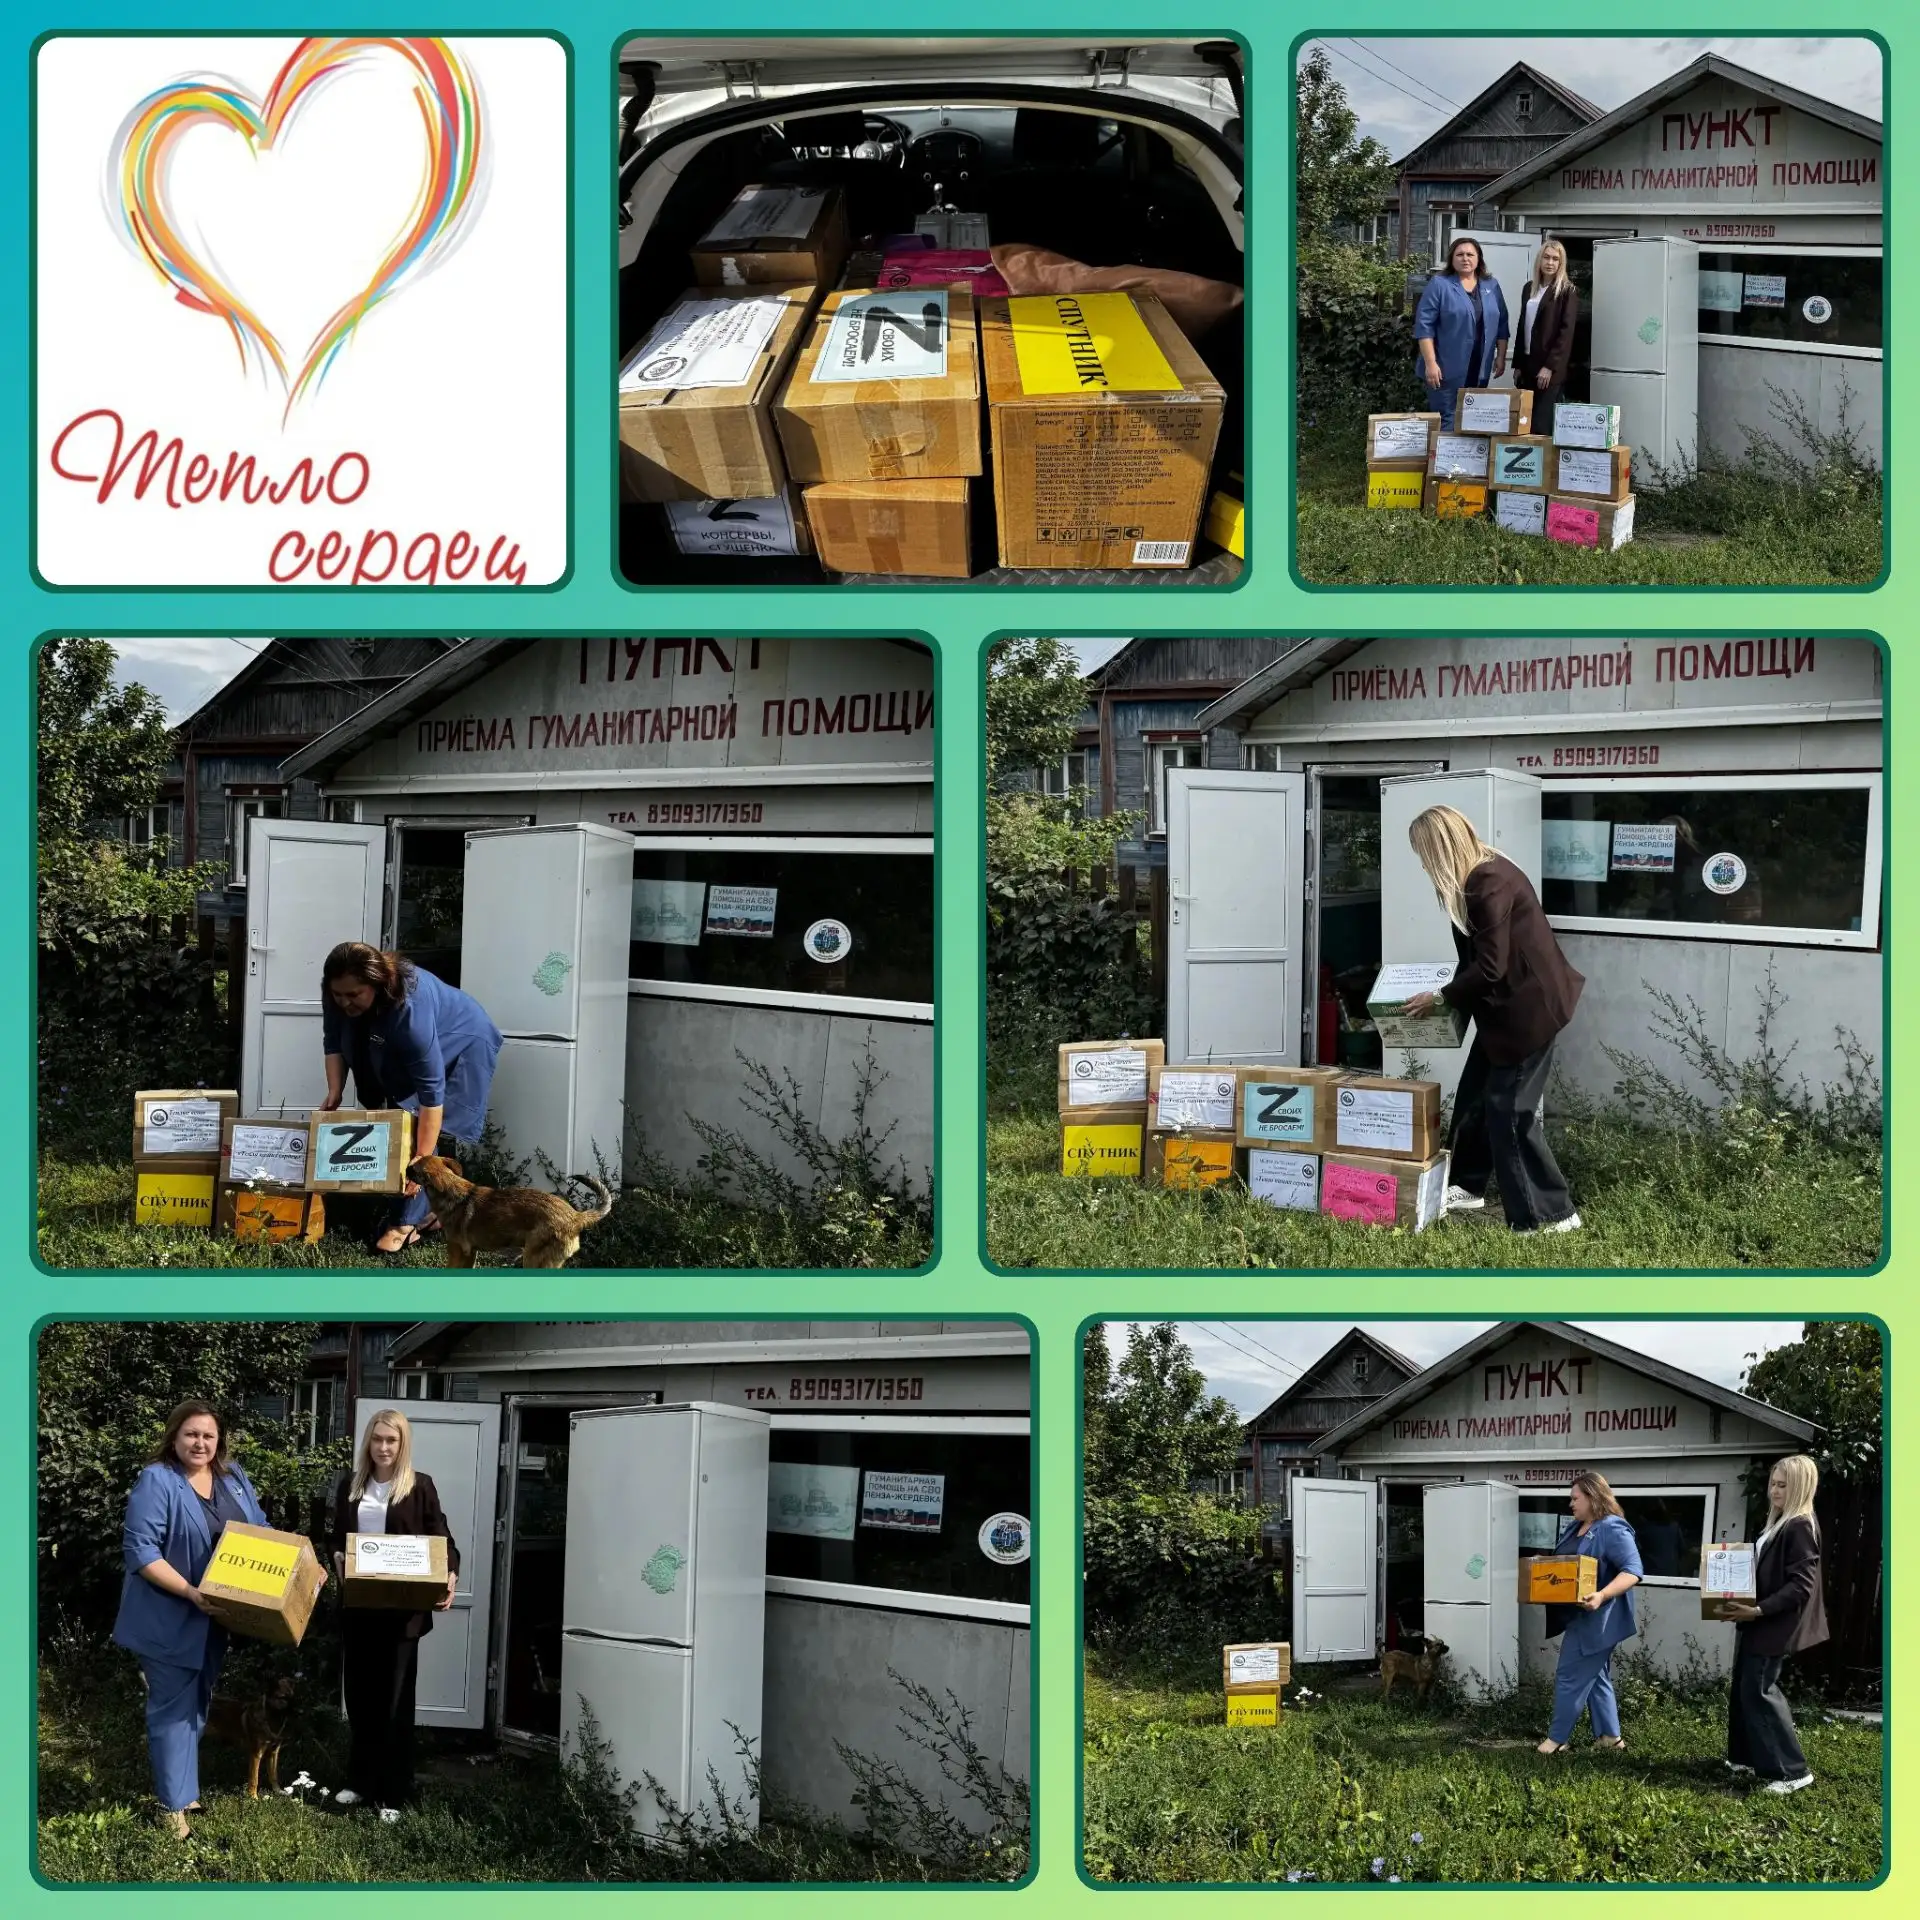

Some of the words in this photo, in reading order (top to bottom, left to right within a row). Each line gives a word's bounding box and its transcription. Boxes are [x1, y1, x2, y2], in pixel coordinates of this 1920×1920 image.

[1661, 106, 1781, 151] ПУНКТ
[1562, 165, 1624, 190] ПРИЁМА
[1631, 158, 1758, 189] ГУМАНИТАРНОЙ
[1773, 158, 1876, 187] ПОМОЩИ
[1706, 224, 1775, 238] 89093171360
[851, 308, 863, 320] НЕ
[842, 320, 862, 367] БРОСАЕМ!
[882, 328, 895, 362] СВОИХ
[1055, 297, 1109, 388] СПУТНИК
[1504, 446, 1535, 473] Z
[1370, 487, 1420, 496] СПУТНИК
[700, 530, 776, 542] КОНСЕРВЫ,
[1332, 665, 1427, 702] ПРИЁМА
[1437, 648, 1632, 699] ГУМАНИТАРНОЙ
[1655, 638, 1815, 683] ПОМОЩИ
[417, 713, 515, 753] ПРИЁМА
[528, 703, 738, 750] ГУМАНИТАРНОЙ
[762, 690, 934, 736] ПОМОЩИ
[1553, 745, 1659, 766] 89093171360
[647, 802, 763, 825] 89093171360
[712, 896, 745, 904] ПОМОЩЬ
[713, 887, 770, 897] ГУМАНИТАРНАЯ
[709, 903, 774, 913] ПЕНЗА-ЖЕРДЕВКА
[1257, 1086, 1303, 1124] Z
[1269, 1124, 1305, 1132] БРОСАЕМ!
[329, 1124, 375, 1164] Z
[351, 1146, 377, 1154] СВОИХ
[1067, 1147, 1138, 1159] СПУТНИК
[329, 1165, 340, 1173] НЕ
[341, 1163, 378, 1172] БРОСАЕМ!
[140, 1196, 210, 1209] СПУТНИК
[1484, 1357, 1592, 1401] ПУНКТ
[789, 1378, 924, 1401] 89093171360
[1393, 1416, 1450, 1440] ПРИЁМА
[1457, 1408, 1572, 1438] ГУМАНИТАРНОЙ
[1584, 1406, 1677, 1432] ПОМОЩИ
[868, 1483, 905, 1492] ПОМОЩЬ
[921, 1485, 941, 1493] СВО
[869, 1474, 936, 1485] ГУМАНИТАРНАЯ
[865, 1491, 941, 1503] ПЕНЗА-ЖЕРДЕВКА
[218, 1552, 290, 1578] СПУТНИК
[1229, 1708, 1274, 1716] СПУТНИК
